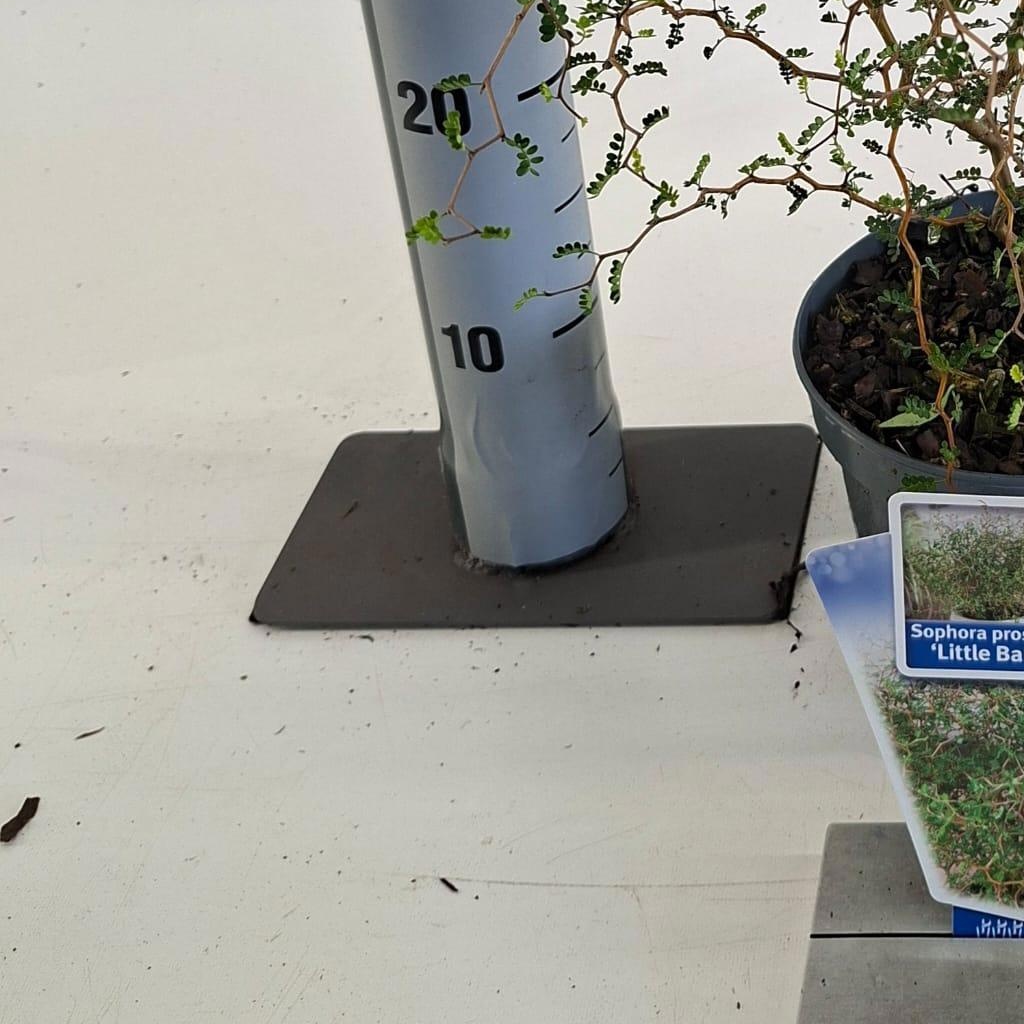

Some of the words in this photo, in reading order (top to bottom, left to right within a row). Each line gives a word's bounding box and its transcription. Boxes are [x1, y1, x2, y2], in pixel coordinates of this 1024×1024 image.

[397, 80, 472, 137] 20
[441, 323, 504, 373] 10
[911, 623, 987, 642] Sophora
[931, 643, 991, 662] ‘Little
